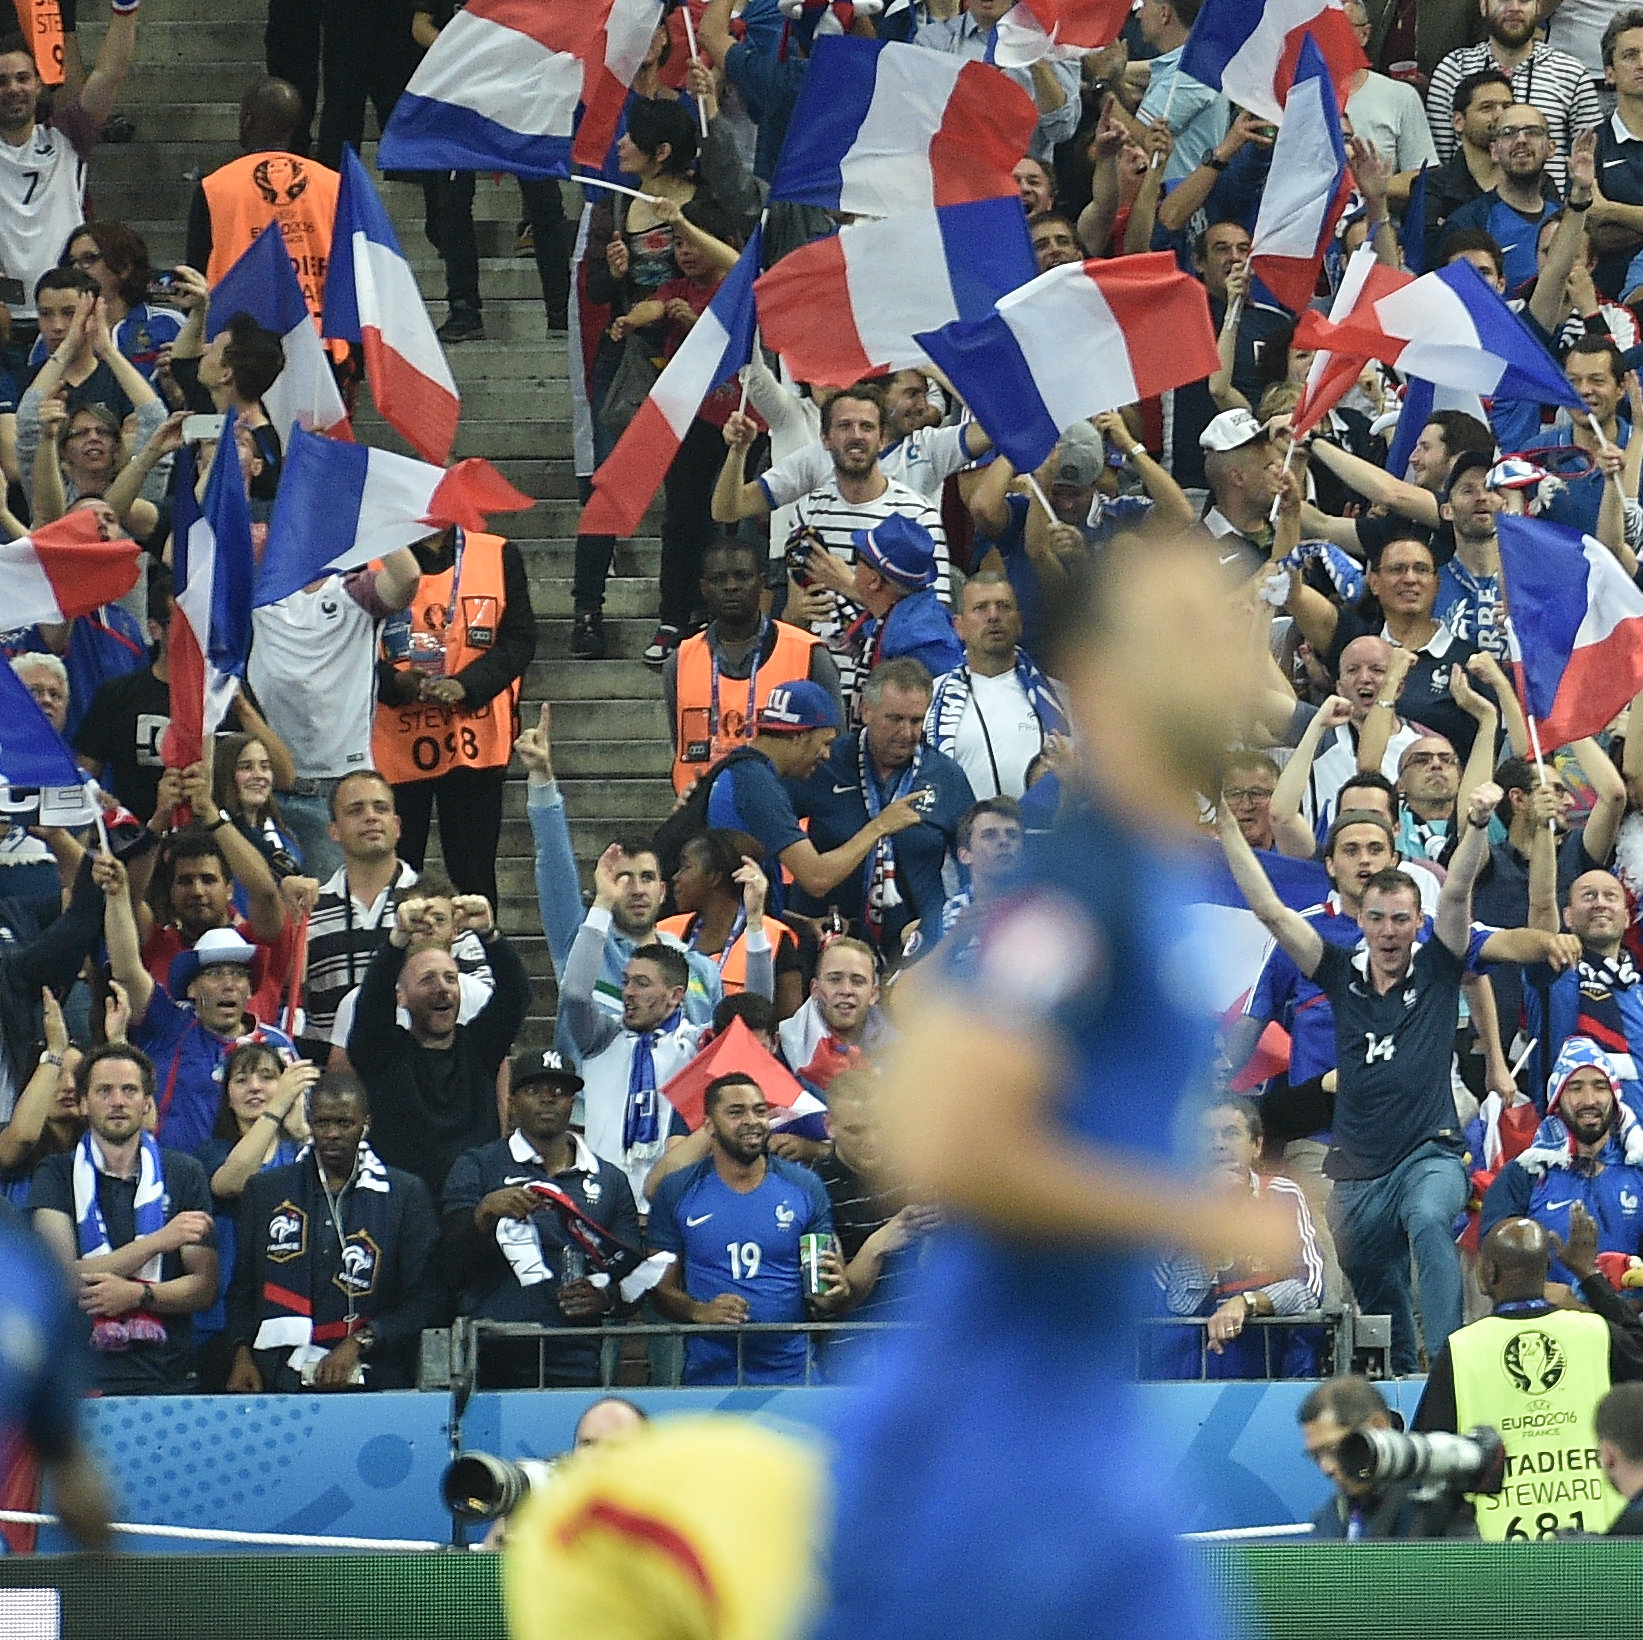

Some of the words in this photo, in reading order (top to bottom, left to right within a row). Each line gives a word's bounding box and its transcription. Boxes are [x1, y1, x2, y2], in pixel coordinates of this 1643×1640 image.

[22, 171, 41, 206] 7
[1364, 1031, 1396, 1065] 14
[726, 1241, 761, 1281] 19
[1502, 1411, 1577, 1431] EURO2016
[1522, 1428, 1561, 1438] FRANCE
[1504, 1448, 1601, 1478] TADIER
[1486, 1478, 1602, 1511] STEWARD
